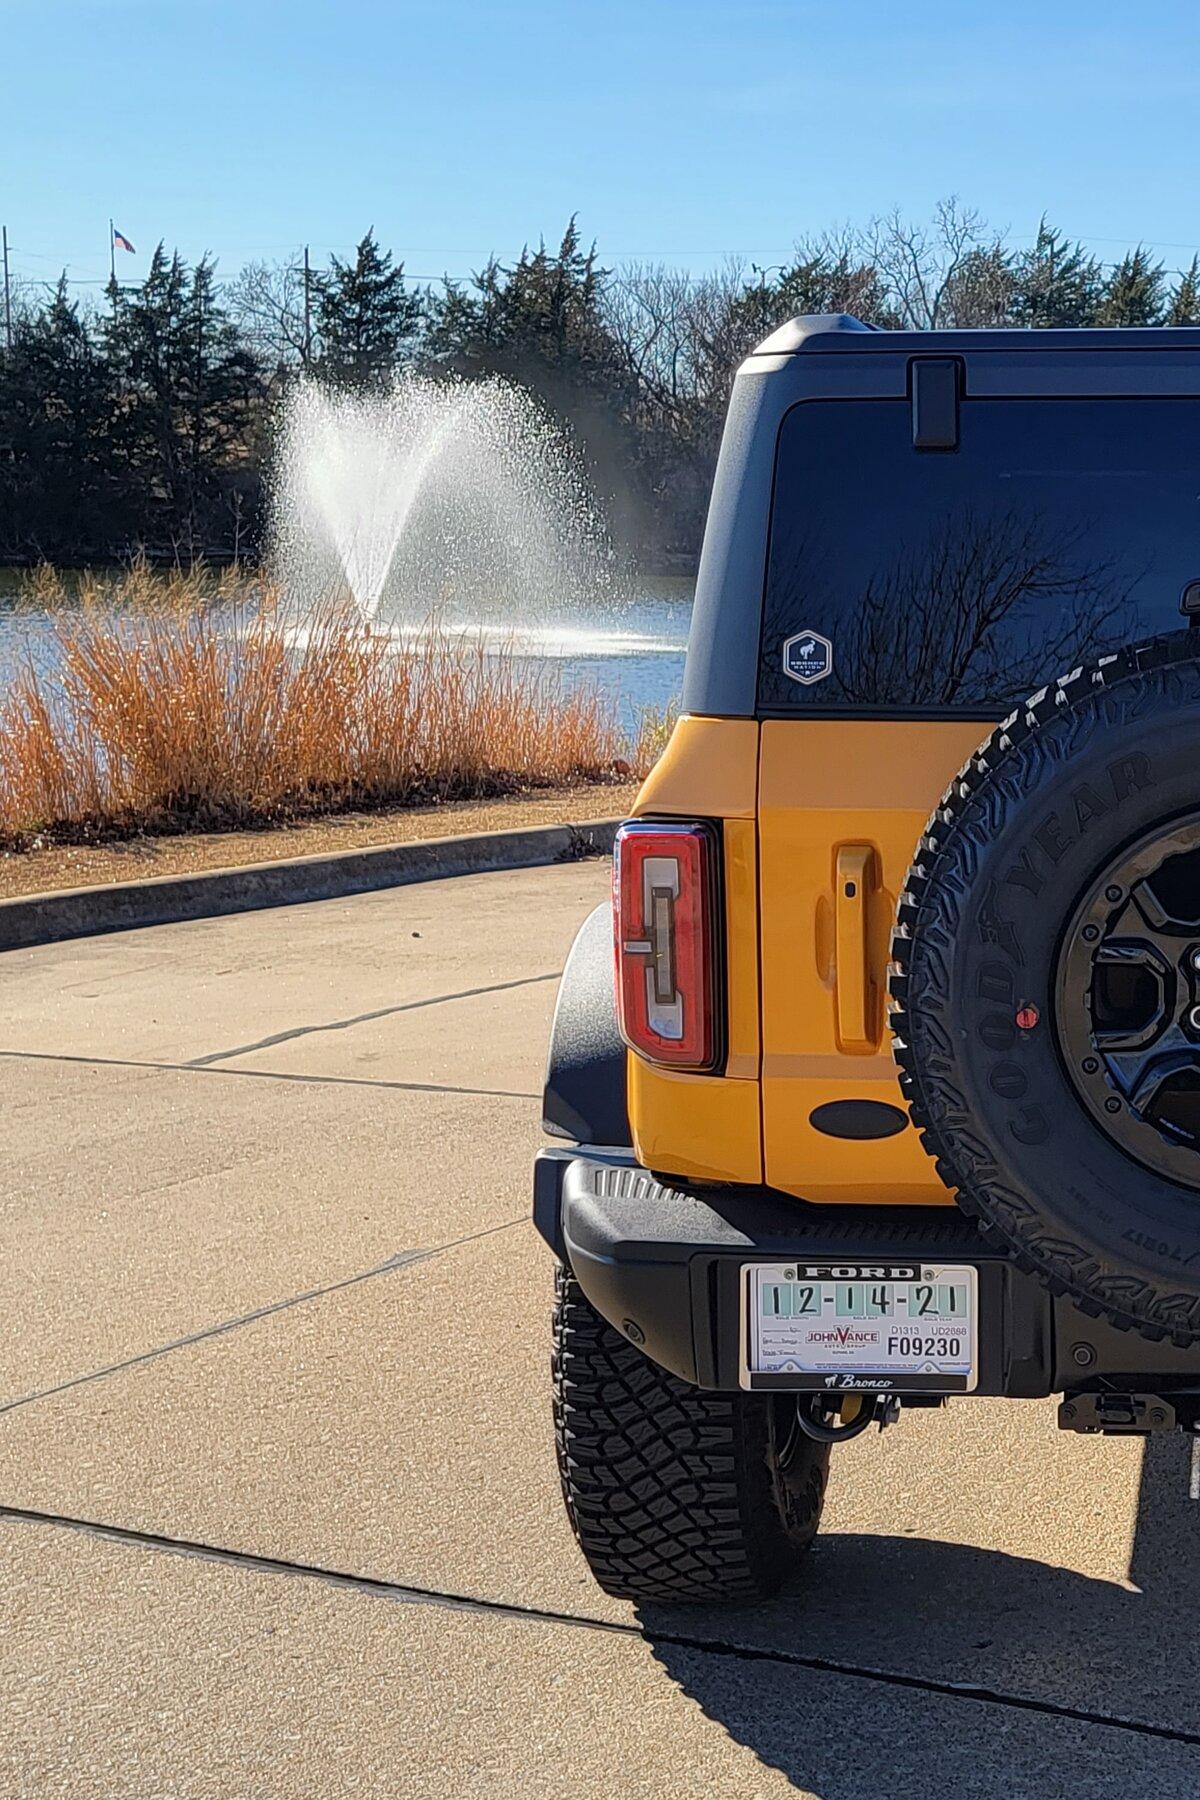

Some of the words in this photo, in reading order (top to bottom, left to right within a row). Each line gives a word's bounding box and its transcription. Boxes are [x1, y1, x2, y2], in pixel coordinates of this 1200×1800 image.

[805, 1267, 915, 1278] FORD
[891, 1326, 919, 1335] D1313
[888, 1337, 960, 1357] F09230
[839, 1374, 893, 1388] Bronco
